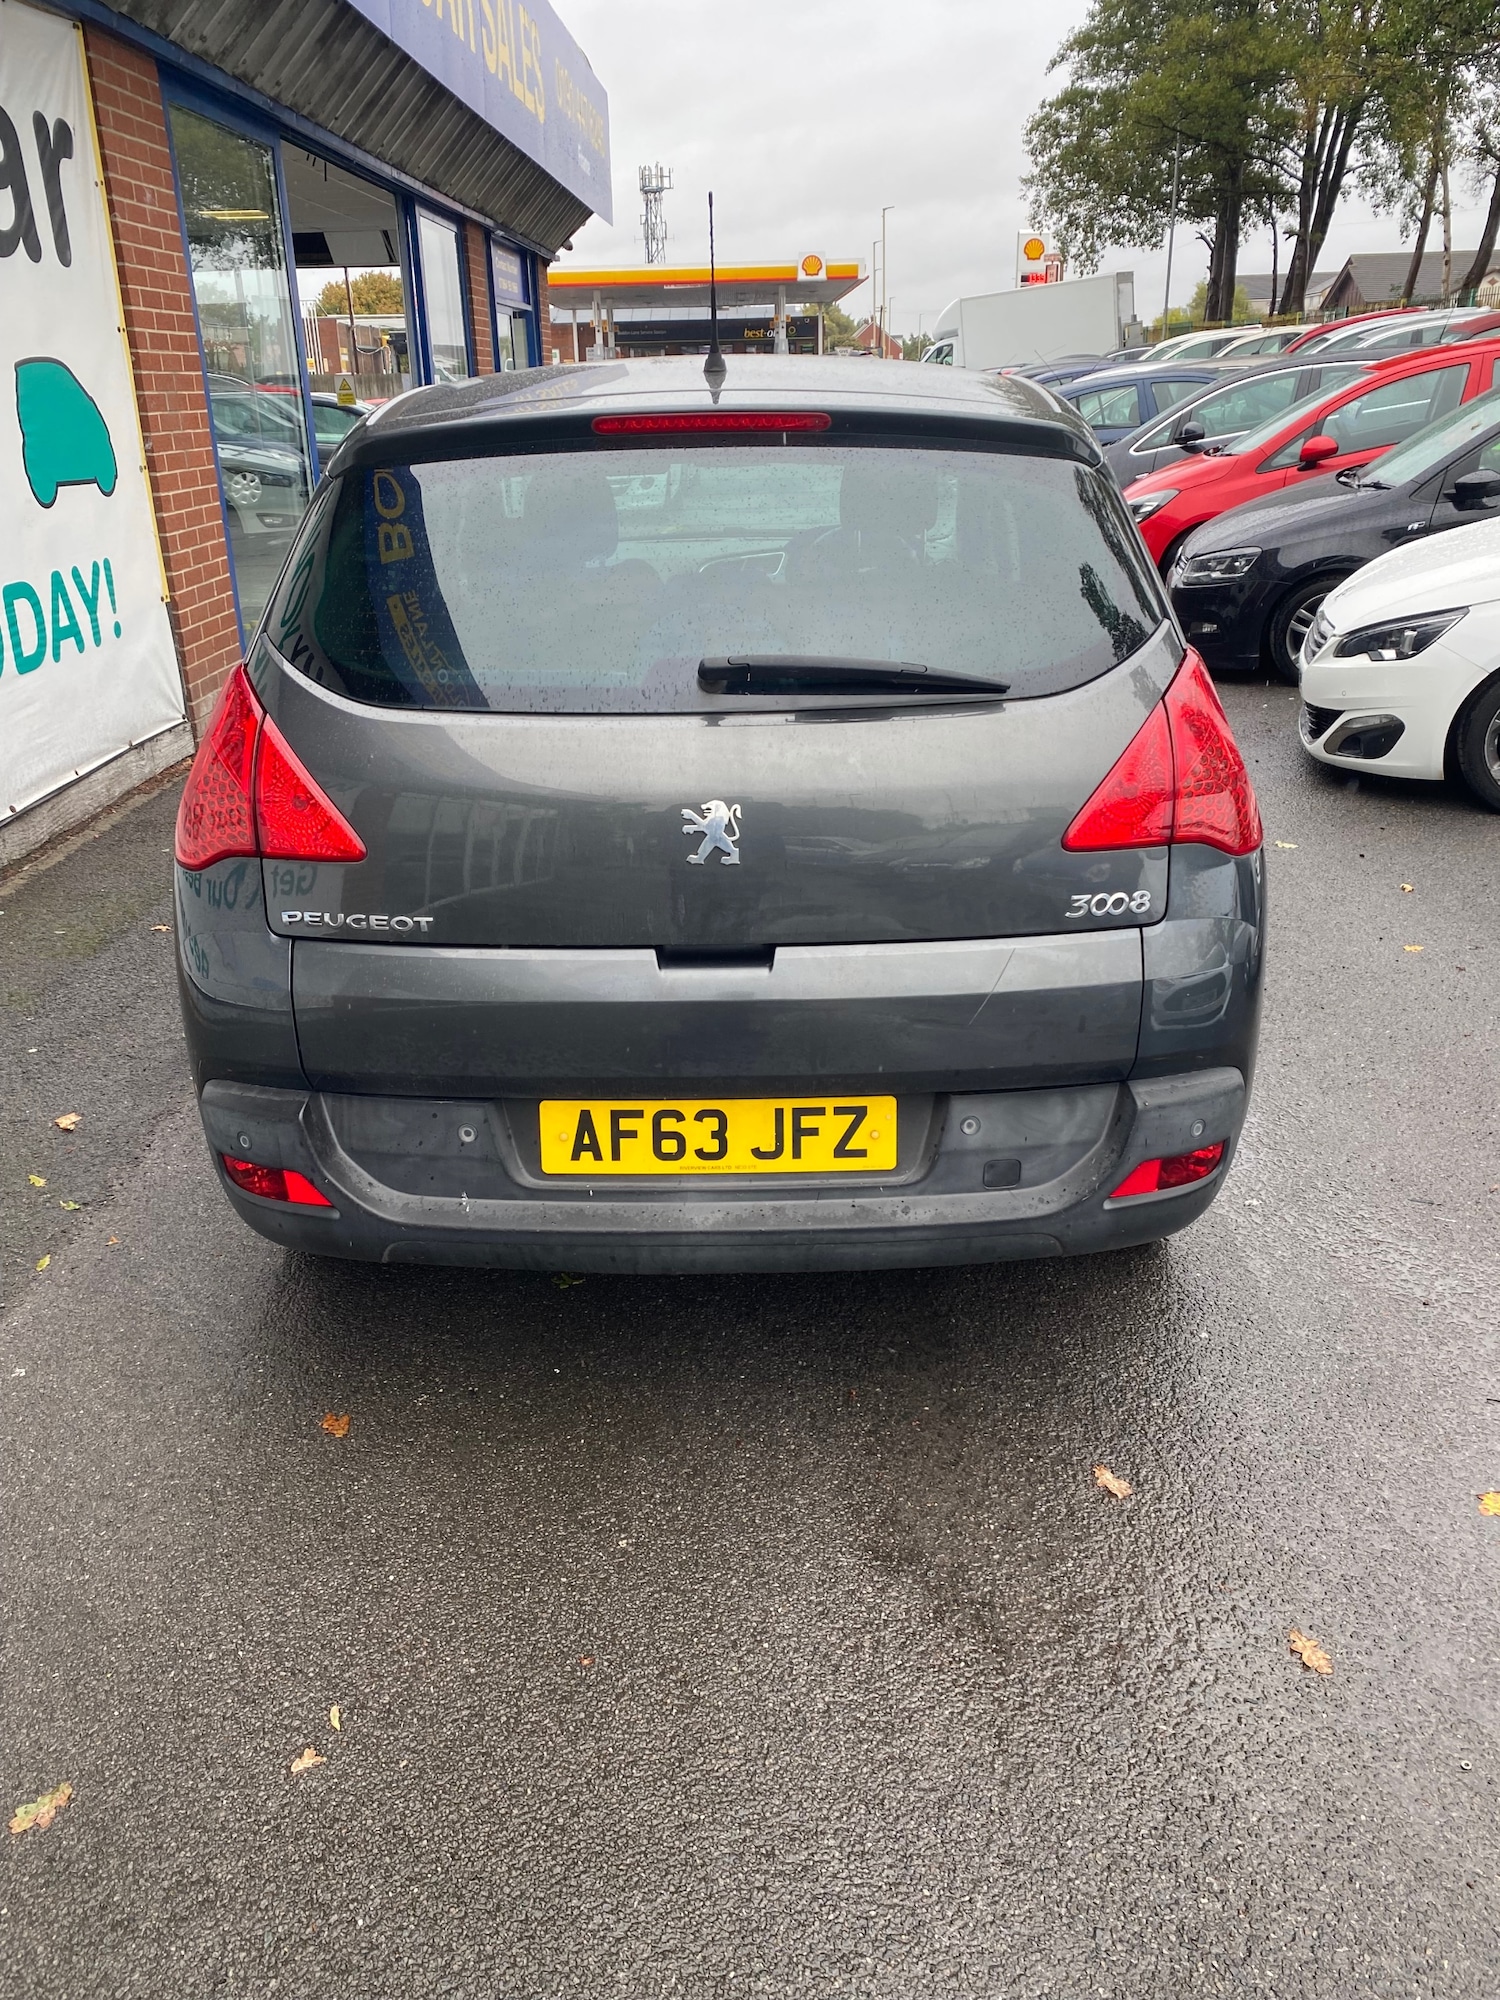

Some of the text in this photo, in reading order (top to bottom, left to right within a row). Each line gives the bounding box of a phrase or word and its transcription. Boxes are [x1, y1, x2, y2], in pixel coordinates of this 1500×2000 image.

[482, 0, 545, 124] SALES
[0, 557, 122, 679] DAY!
[281, 910, 434, 933] PEUGEOT
[1064, 890, 1151, 919] 3008
[571, 1105, 868, 1162] AF63 JFZ
